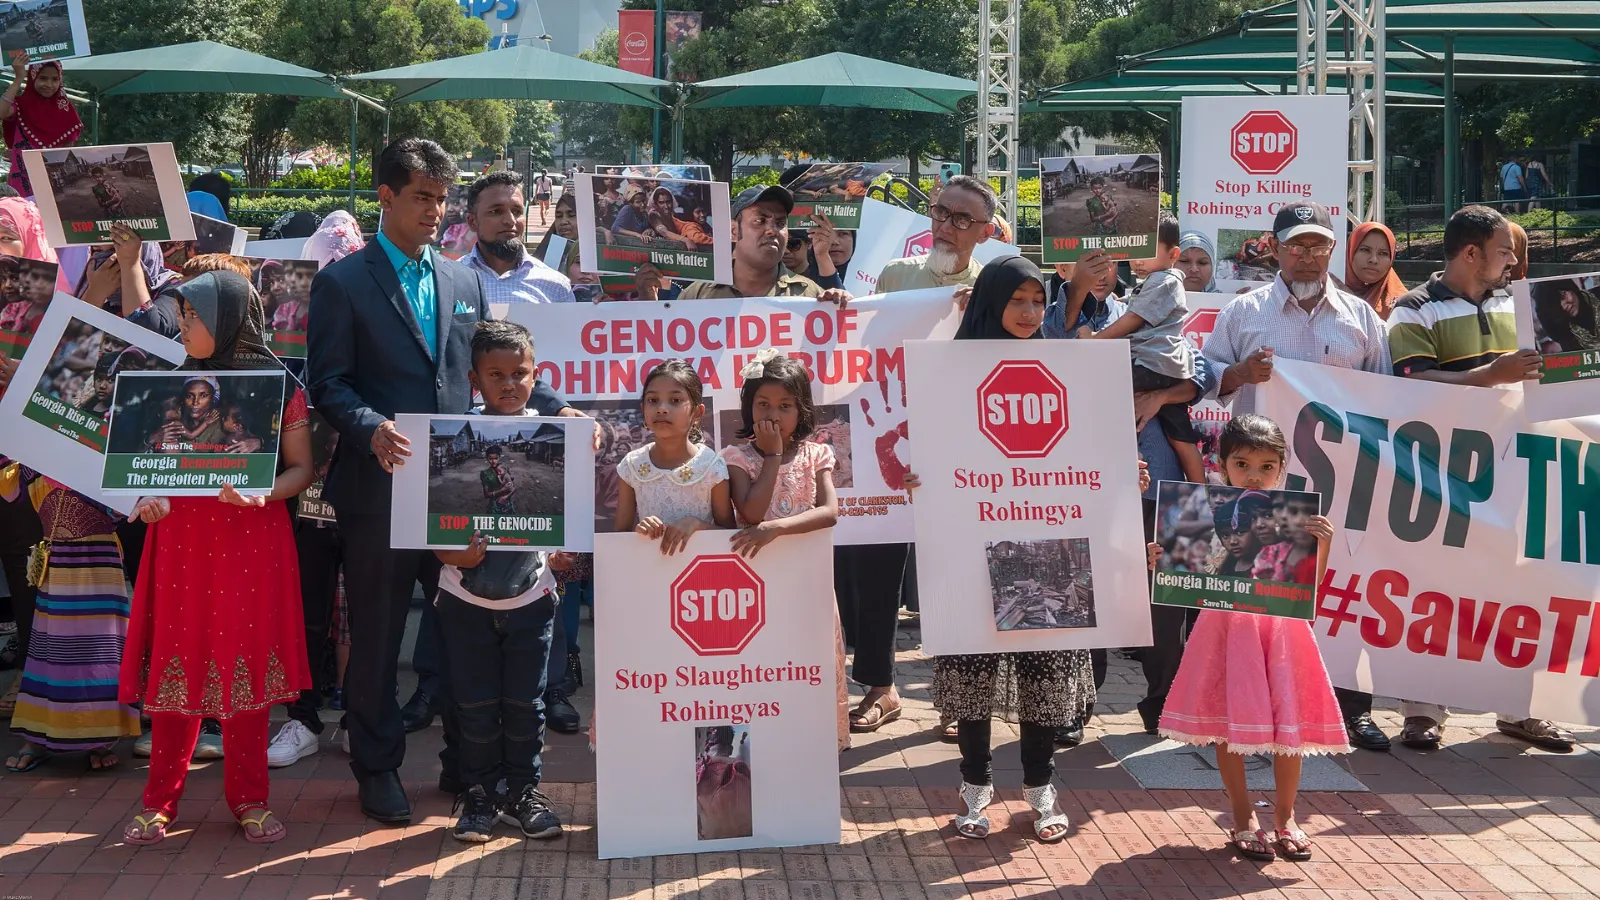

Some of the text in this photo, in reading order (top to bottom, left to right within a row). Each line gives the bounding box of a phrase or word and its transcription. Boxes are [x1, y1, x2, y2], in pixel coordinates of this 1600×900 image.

[25, 46, 38, 55] THE
[39, 42, 68, 53] GENOCIDE
[1237, 132, 1291, 154] STOP
[1215, 180, 1312, 197] Stop Killing
[833, 205, 857, 217] Matter
[1187, 201, 1262, 219] Rohingya
[72, 221, 94, 232] STOP
[1053, 234, 1148, 250] STOP THE GENOCIDE
[677, 253, 708, 267] Matter
[580, 309, 858, 355] GENOCIDE OF
[31, 391, 65, 416] Georgia
[66, 407, 85, 426] Rise
[84, 415, 100, 432] for
[987, 392, 1058, 425] STOP
[132, 456, 247, 470] Georgia Remembers
[126, 472, 249, 487] The Forgotten People
[954, 465, 1102, 493] Stop Burning
[1285, 400, 1494, 548] STOP
[303, 500, 320, 514] The
[845, 497, 857, 507] OF
[858, 495, 907, 506] CLARKSTON,
[977, 500, 1083, 526] Rohingya
[440, 515, 553, 531] STOP THE GENOCIDE
[1156, 572, 1312, 601] Georgia Rise for Rohingya
[680, 587, 755, 623] STOP
[615, 661, 822, 694] Stop Slaughtering
[660, 700, 781, 724] Rohingyas
